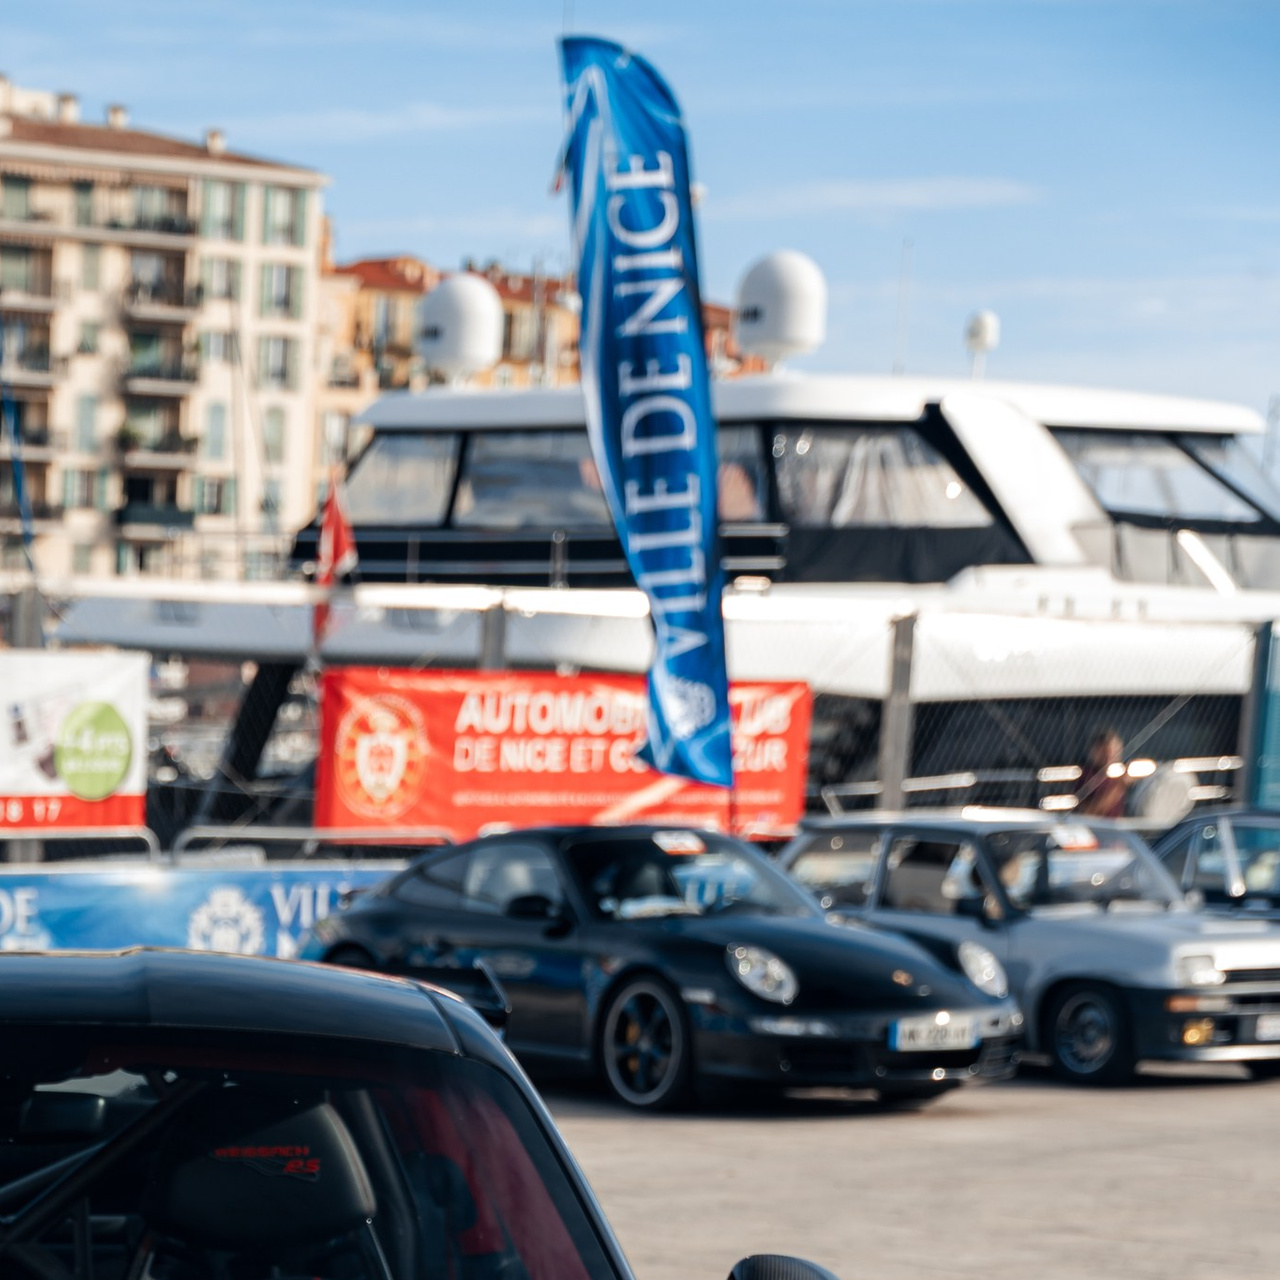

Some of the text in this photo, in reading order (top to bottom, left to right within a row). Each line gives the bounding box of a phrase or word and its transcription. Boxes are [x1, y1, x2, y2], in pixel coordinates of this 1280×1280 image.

[606, 149, 689, 338] NICE
[618, 353, 699, 457] DE
[626, 472, 710, 656] VILLE
[453, 736, 497, 772] DE
[500, 737, 568, 773] NICE
[570, 737, 607, 773] ET
